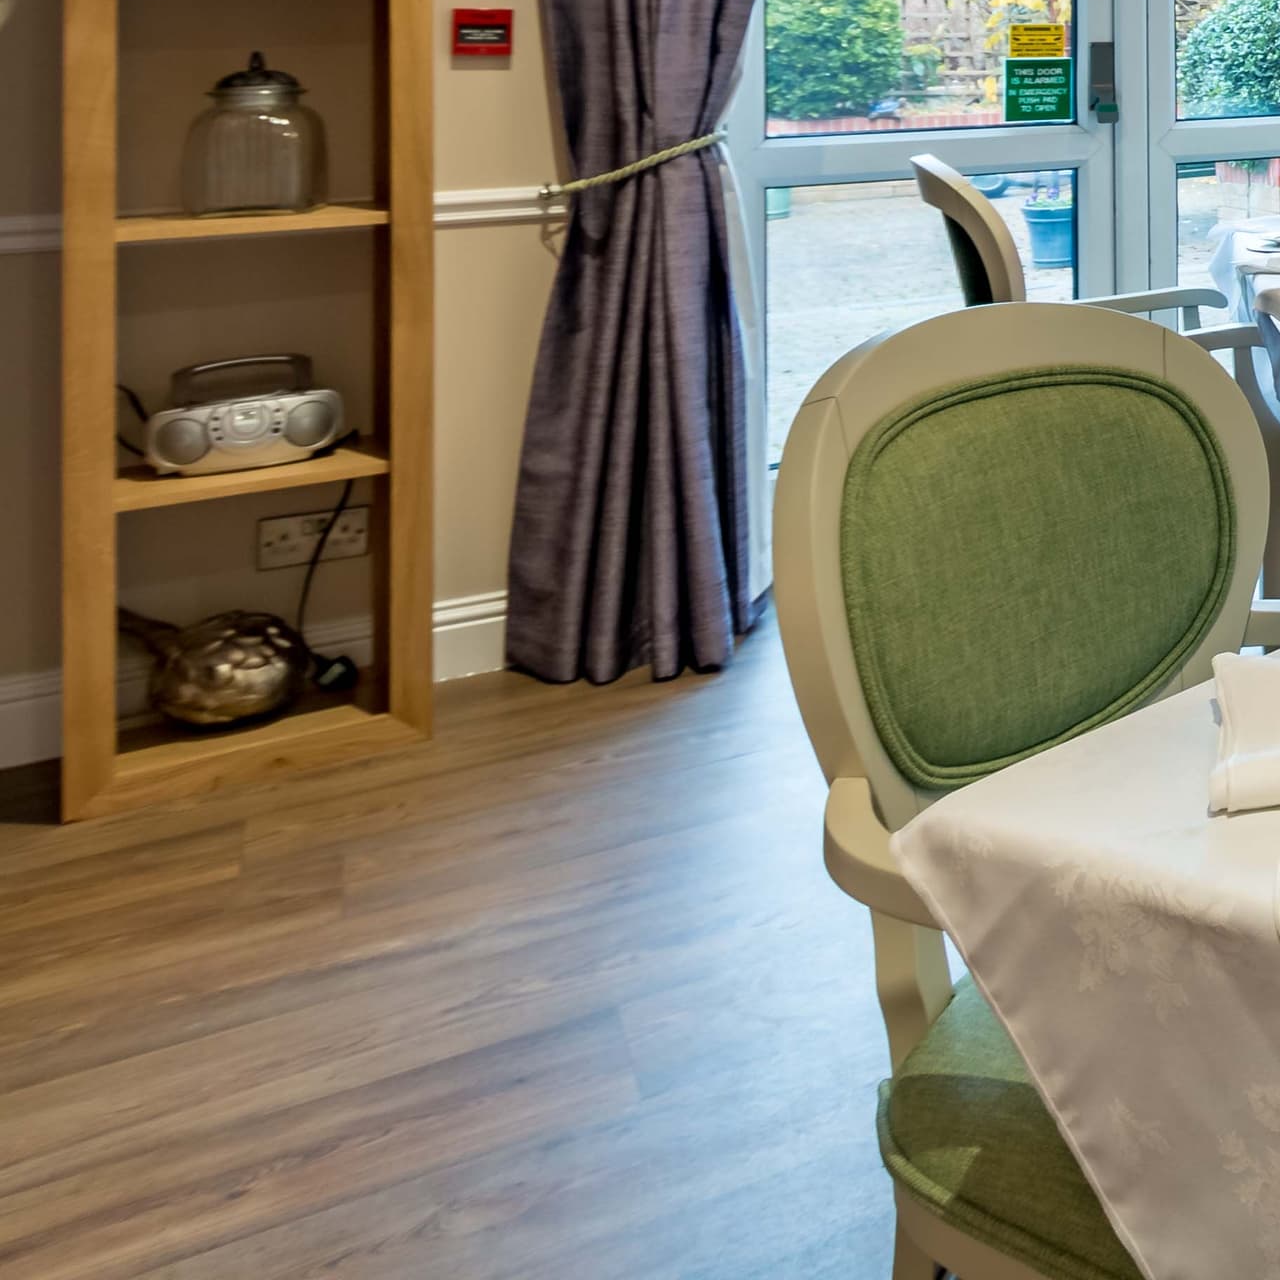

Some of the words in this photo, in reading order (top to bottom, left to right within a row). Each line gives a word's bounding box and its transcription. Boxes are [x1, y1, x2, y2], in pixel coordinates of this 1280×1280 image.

[1013, 68, 1034, 76] THIS
[1037, 68, 1063, 76] DOOR
[1010, 77, 1021, 85] IS
[1023, 76, 1065, 84] ALARMED
[1018, 88, 1068, 96] EMERGENCY
[1034, 104, 1056, 112] OPEN
